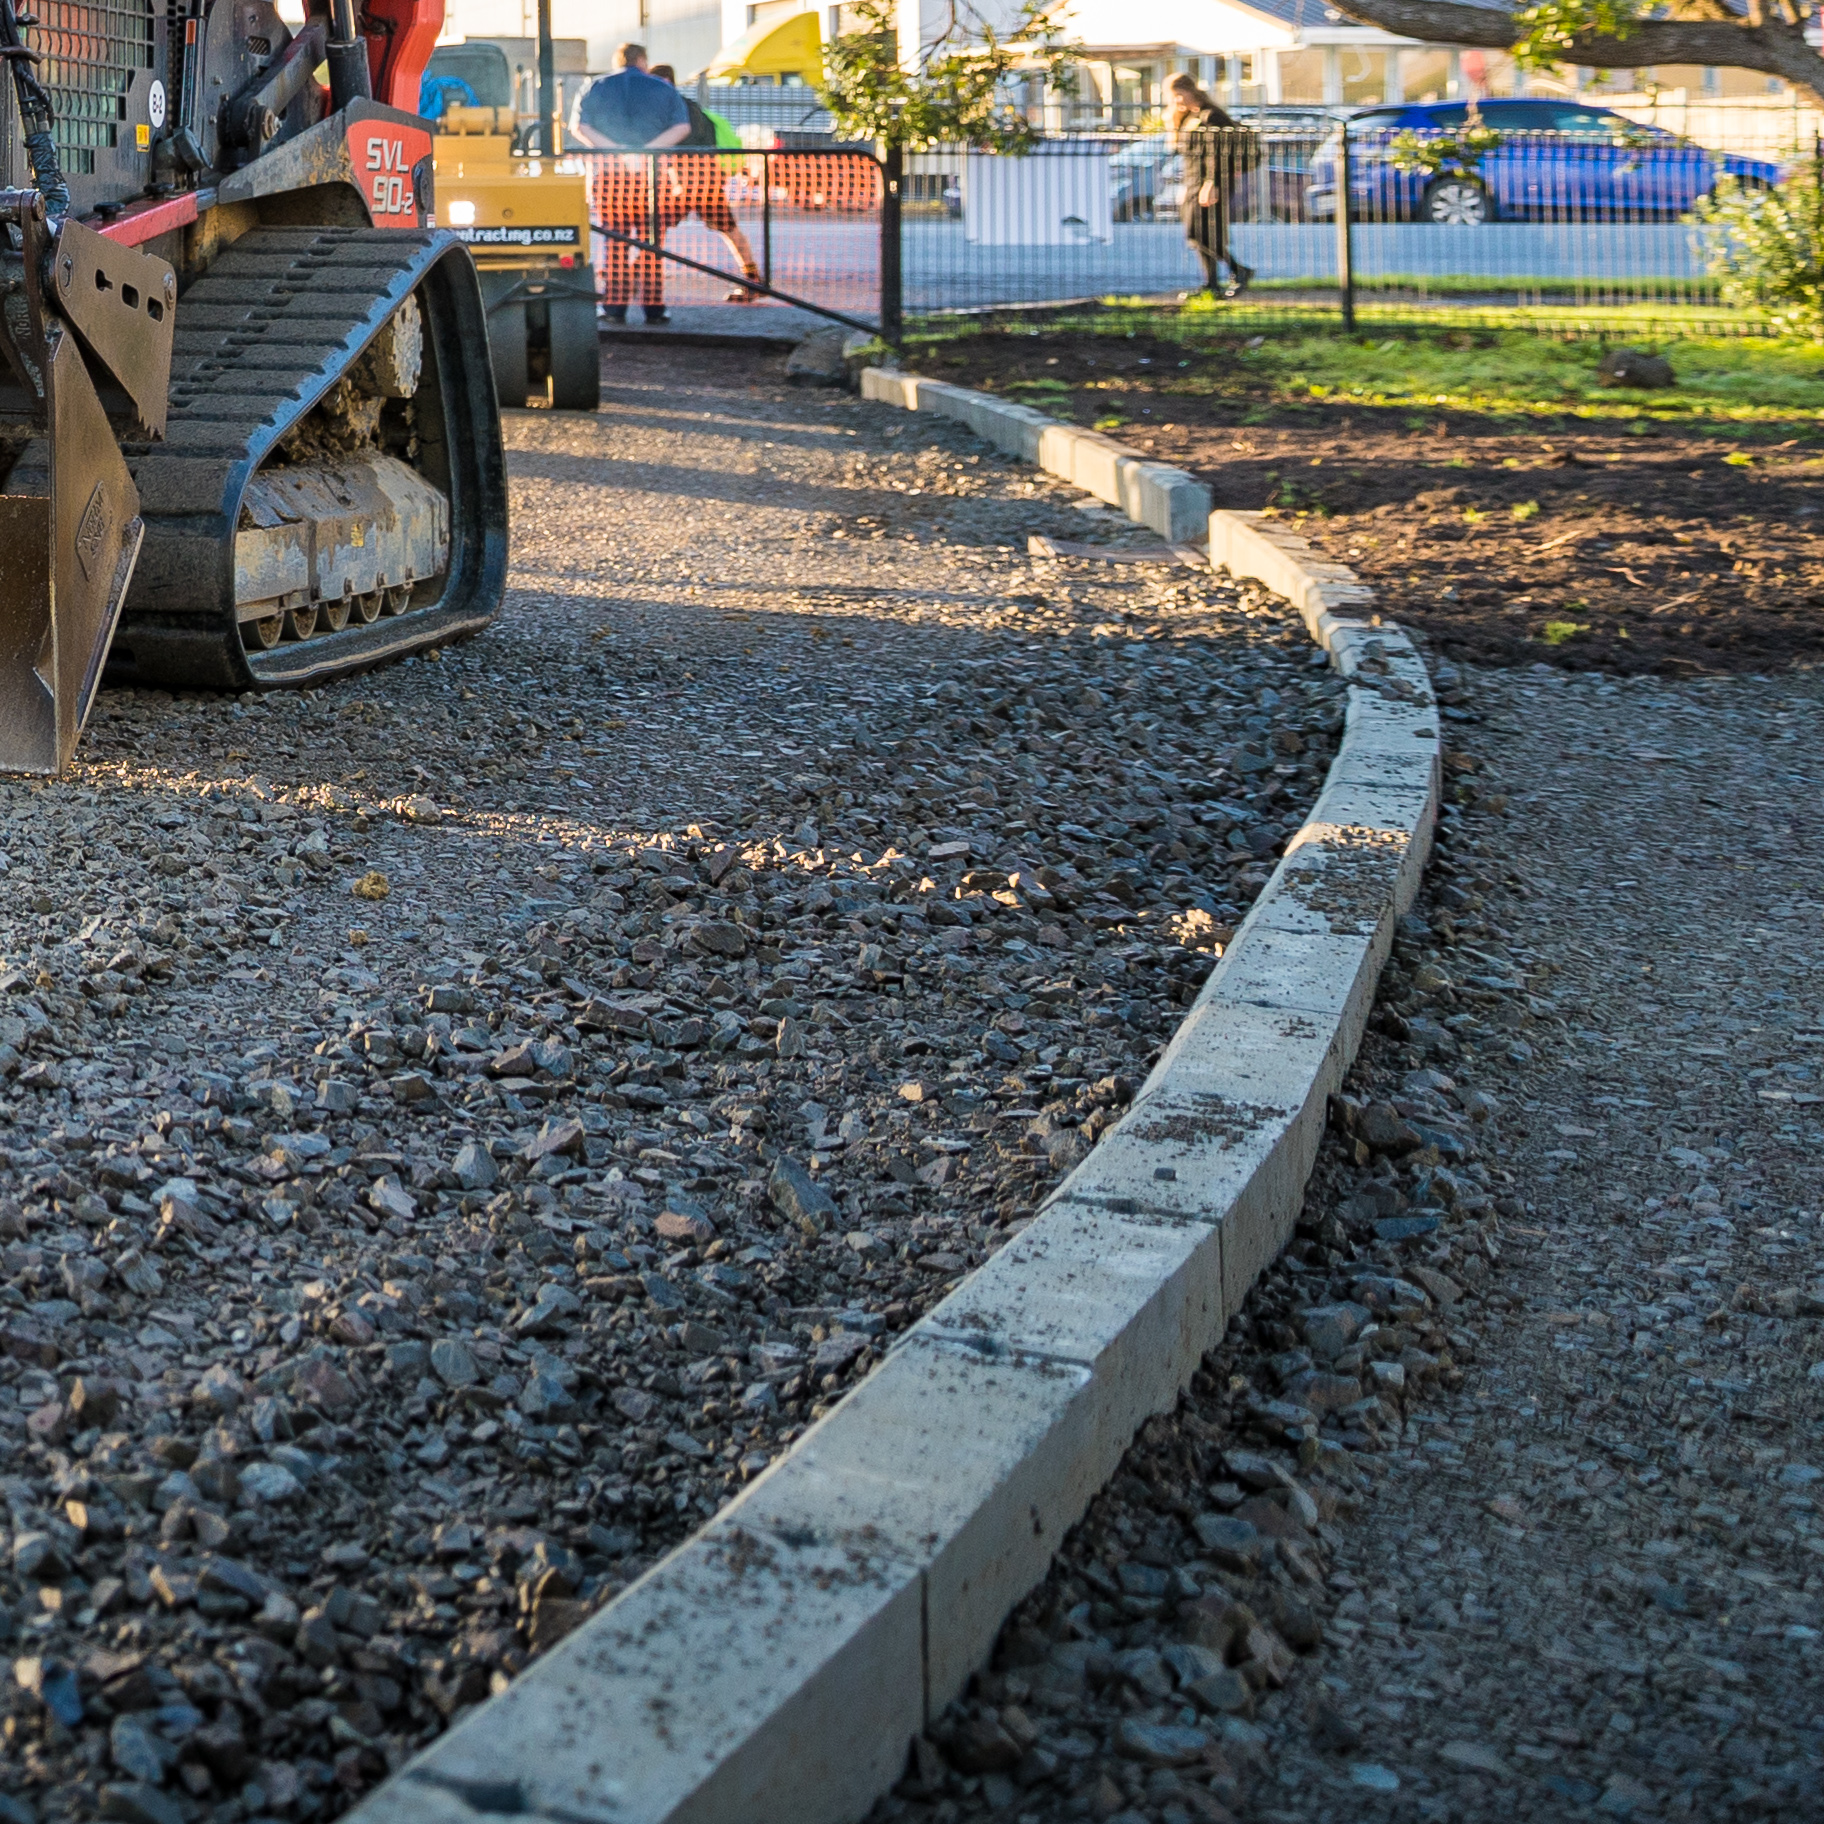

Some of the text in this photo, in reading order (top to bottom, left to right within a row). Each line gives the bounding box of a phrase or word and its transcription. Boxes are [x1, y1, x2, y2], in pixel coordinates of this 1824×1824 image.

[152, 93, 163, 114] B-2
[366, 138, 409, 172] SVL
[372, 176, 414, 214] 90-2
